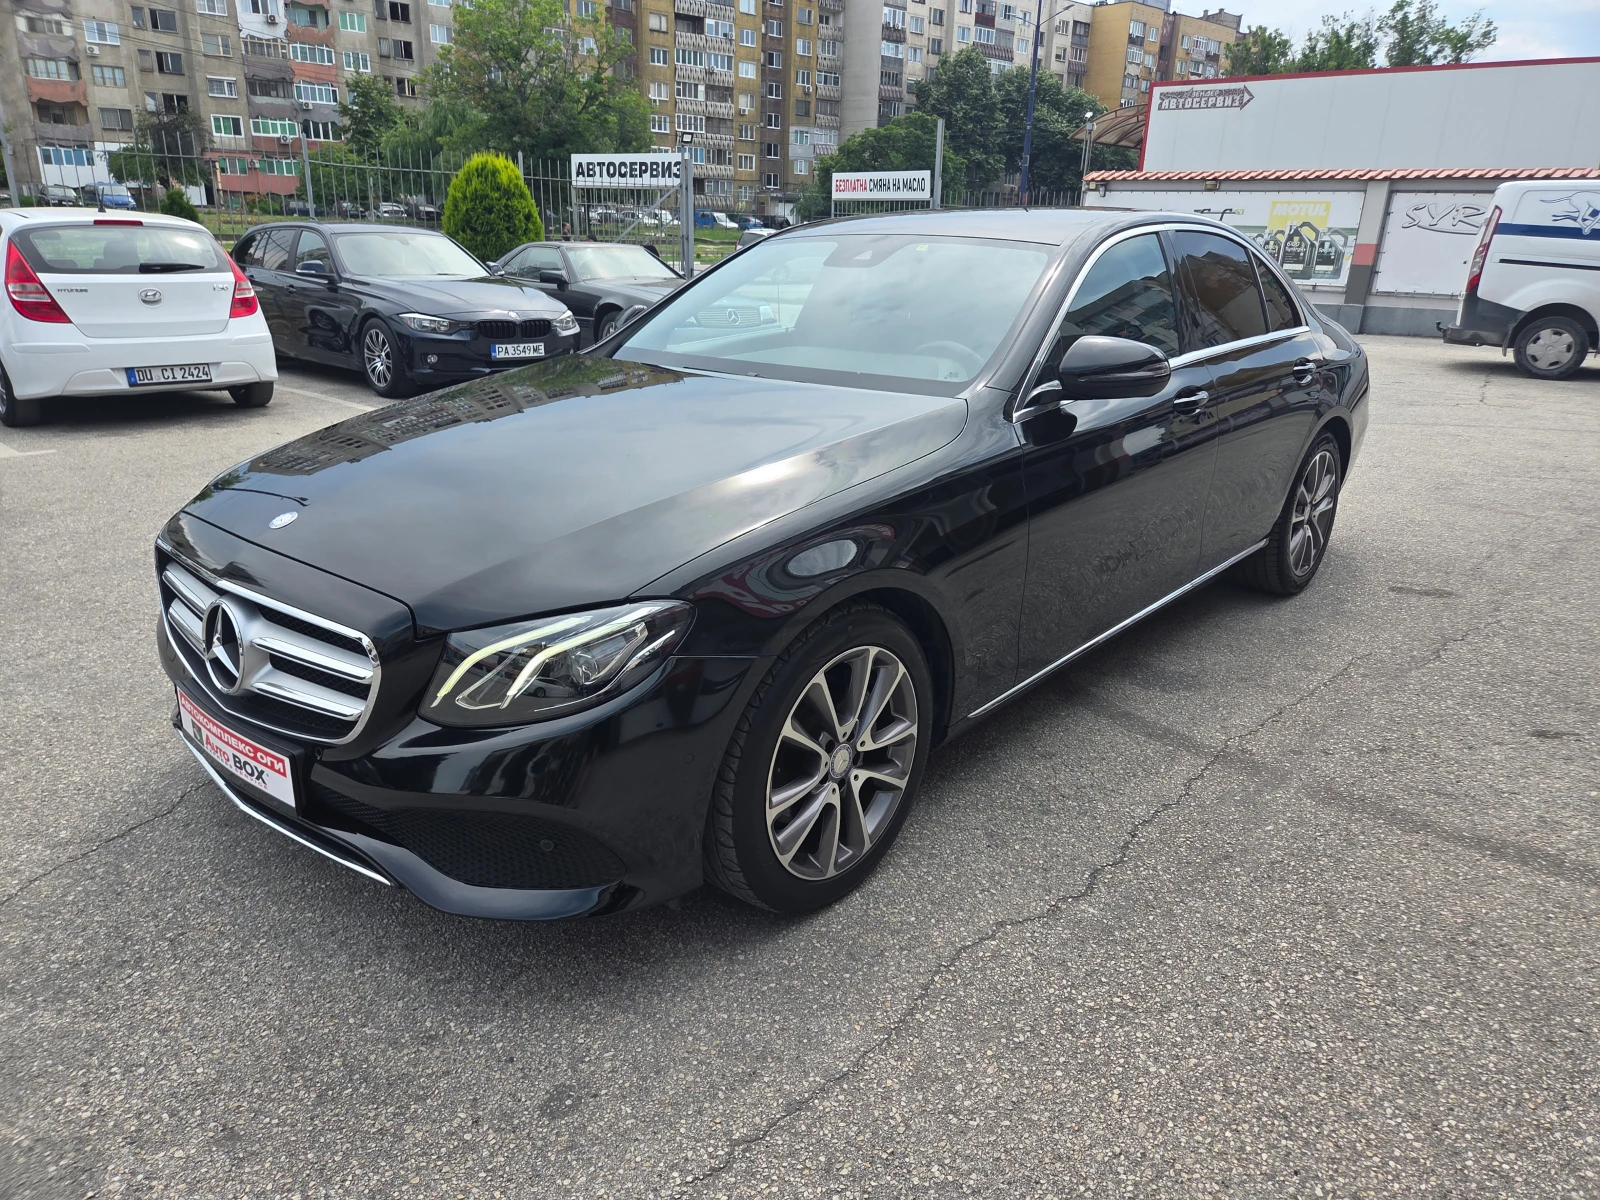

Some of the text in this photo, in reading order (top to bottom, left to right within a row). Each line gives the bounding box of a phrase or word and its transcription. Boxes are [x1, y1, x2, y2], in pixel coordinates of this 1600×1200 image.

[1161, 94, 1241, 110] АВТОСЕРВИЗ
[576, 161, 681, 178] АВТОСЕРВИЗ
[835, 177, 925, 192] БЕЗПЛАТНА СМЯНА НА МАСЛО
[1273, 203, 1327, 216] MOTUL
[511, 345, 532, 356] 3549
[136, 369, 153, 382] DU
[180, 366, 208, 379] 2424
[181, 697, 284, 773] АВТОКОМПЛЕКС ОГИ
[232, 753, 268, 785] BOX
[234, 768, 268, 790] SERVICE
